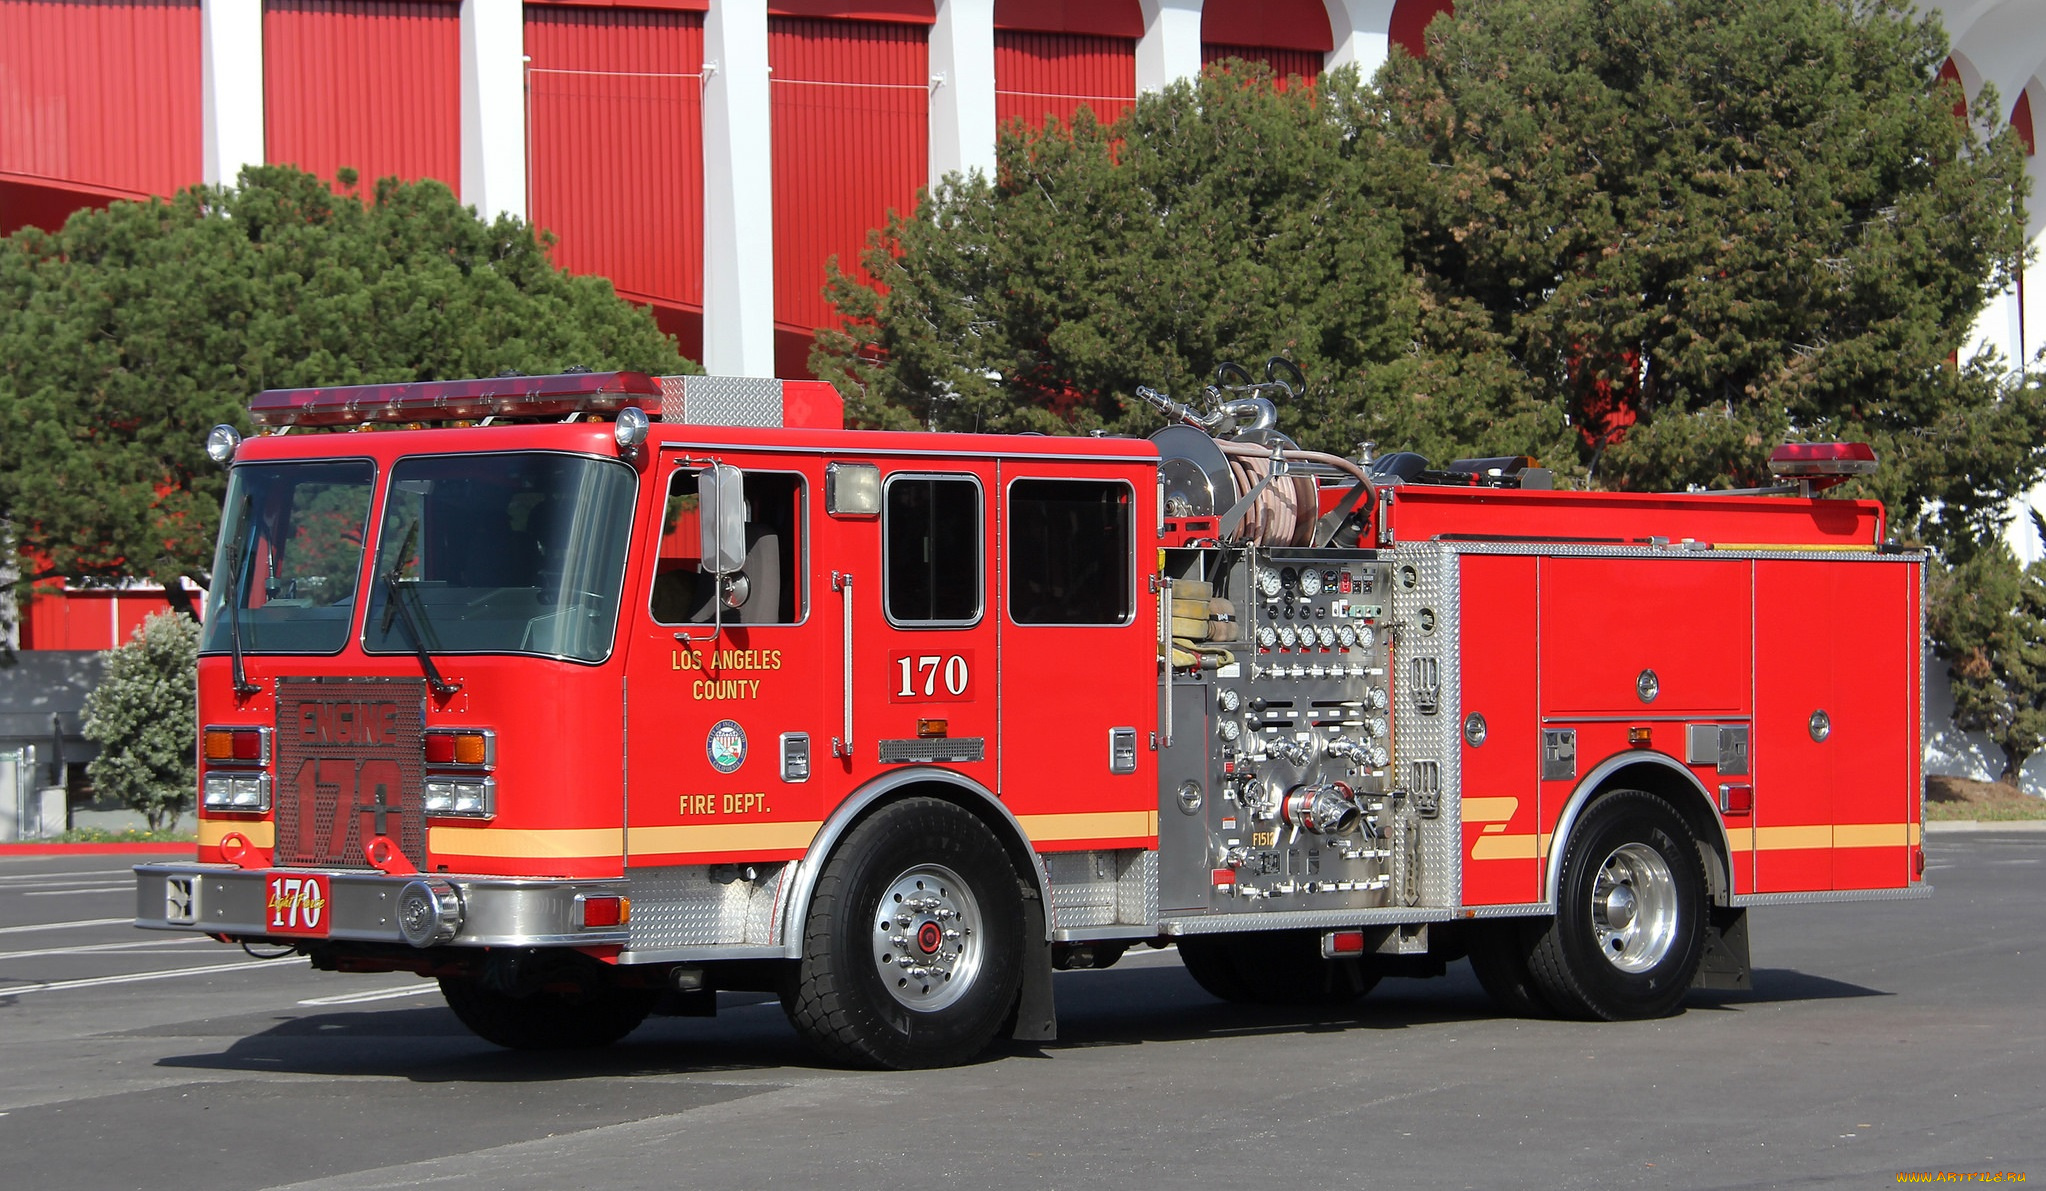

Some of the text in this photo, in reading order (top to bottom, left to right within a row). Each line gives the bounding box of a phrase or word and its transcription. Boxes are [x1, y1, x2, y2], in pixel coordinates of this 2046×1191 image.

[672, 650, 782, 670] LOS ANGELES
[897, 654, 969, 696] 170
[692, 680, 760, 700] COUNTY
[299, 702, 397, 743] ENGINE
[290, 759, 402, 858] 170
[680, 793, 771, 815] FIRE DEPT.
[268, 893, 326, 912] Light Force
[271, 877, 321, 928] 170
